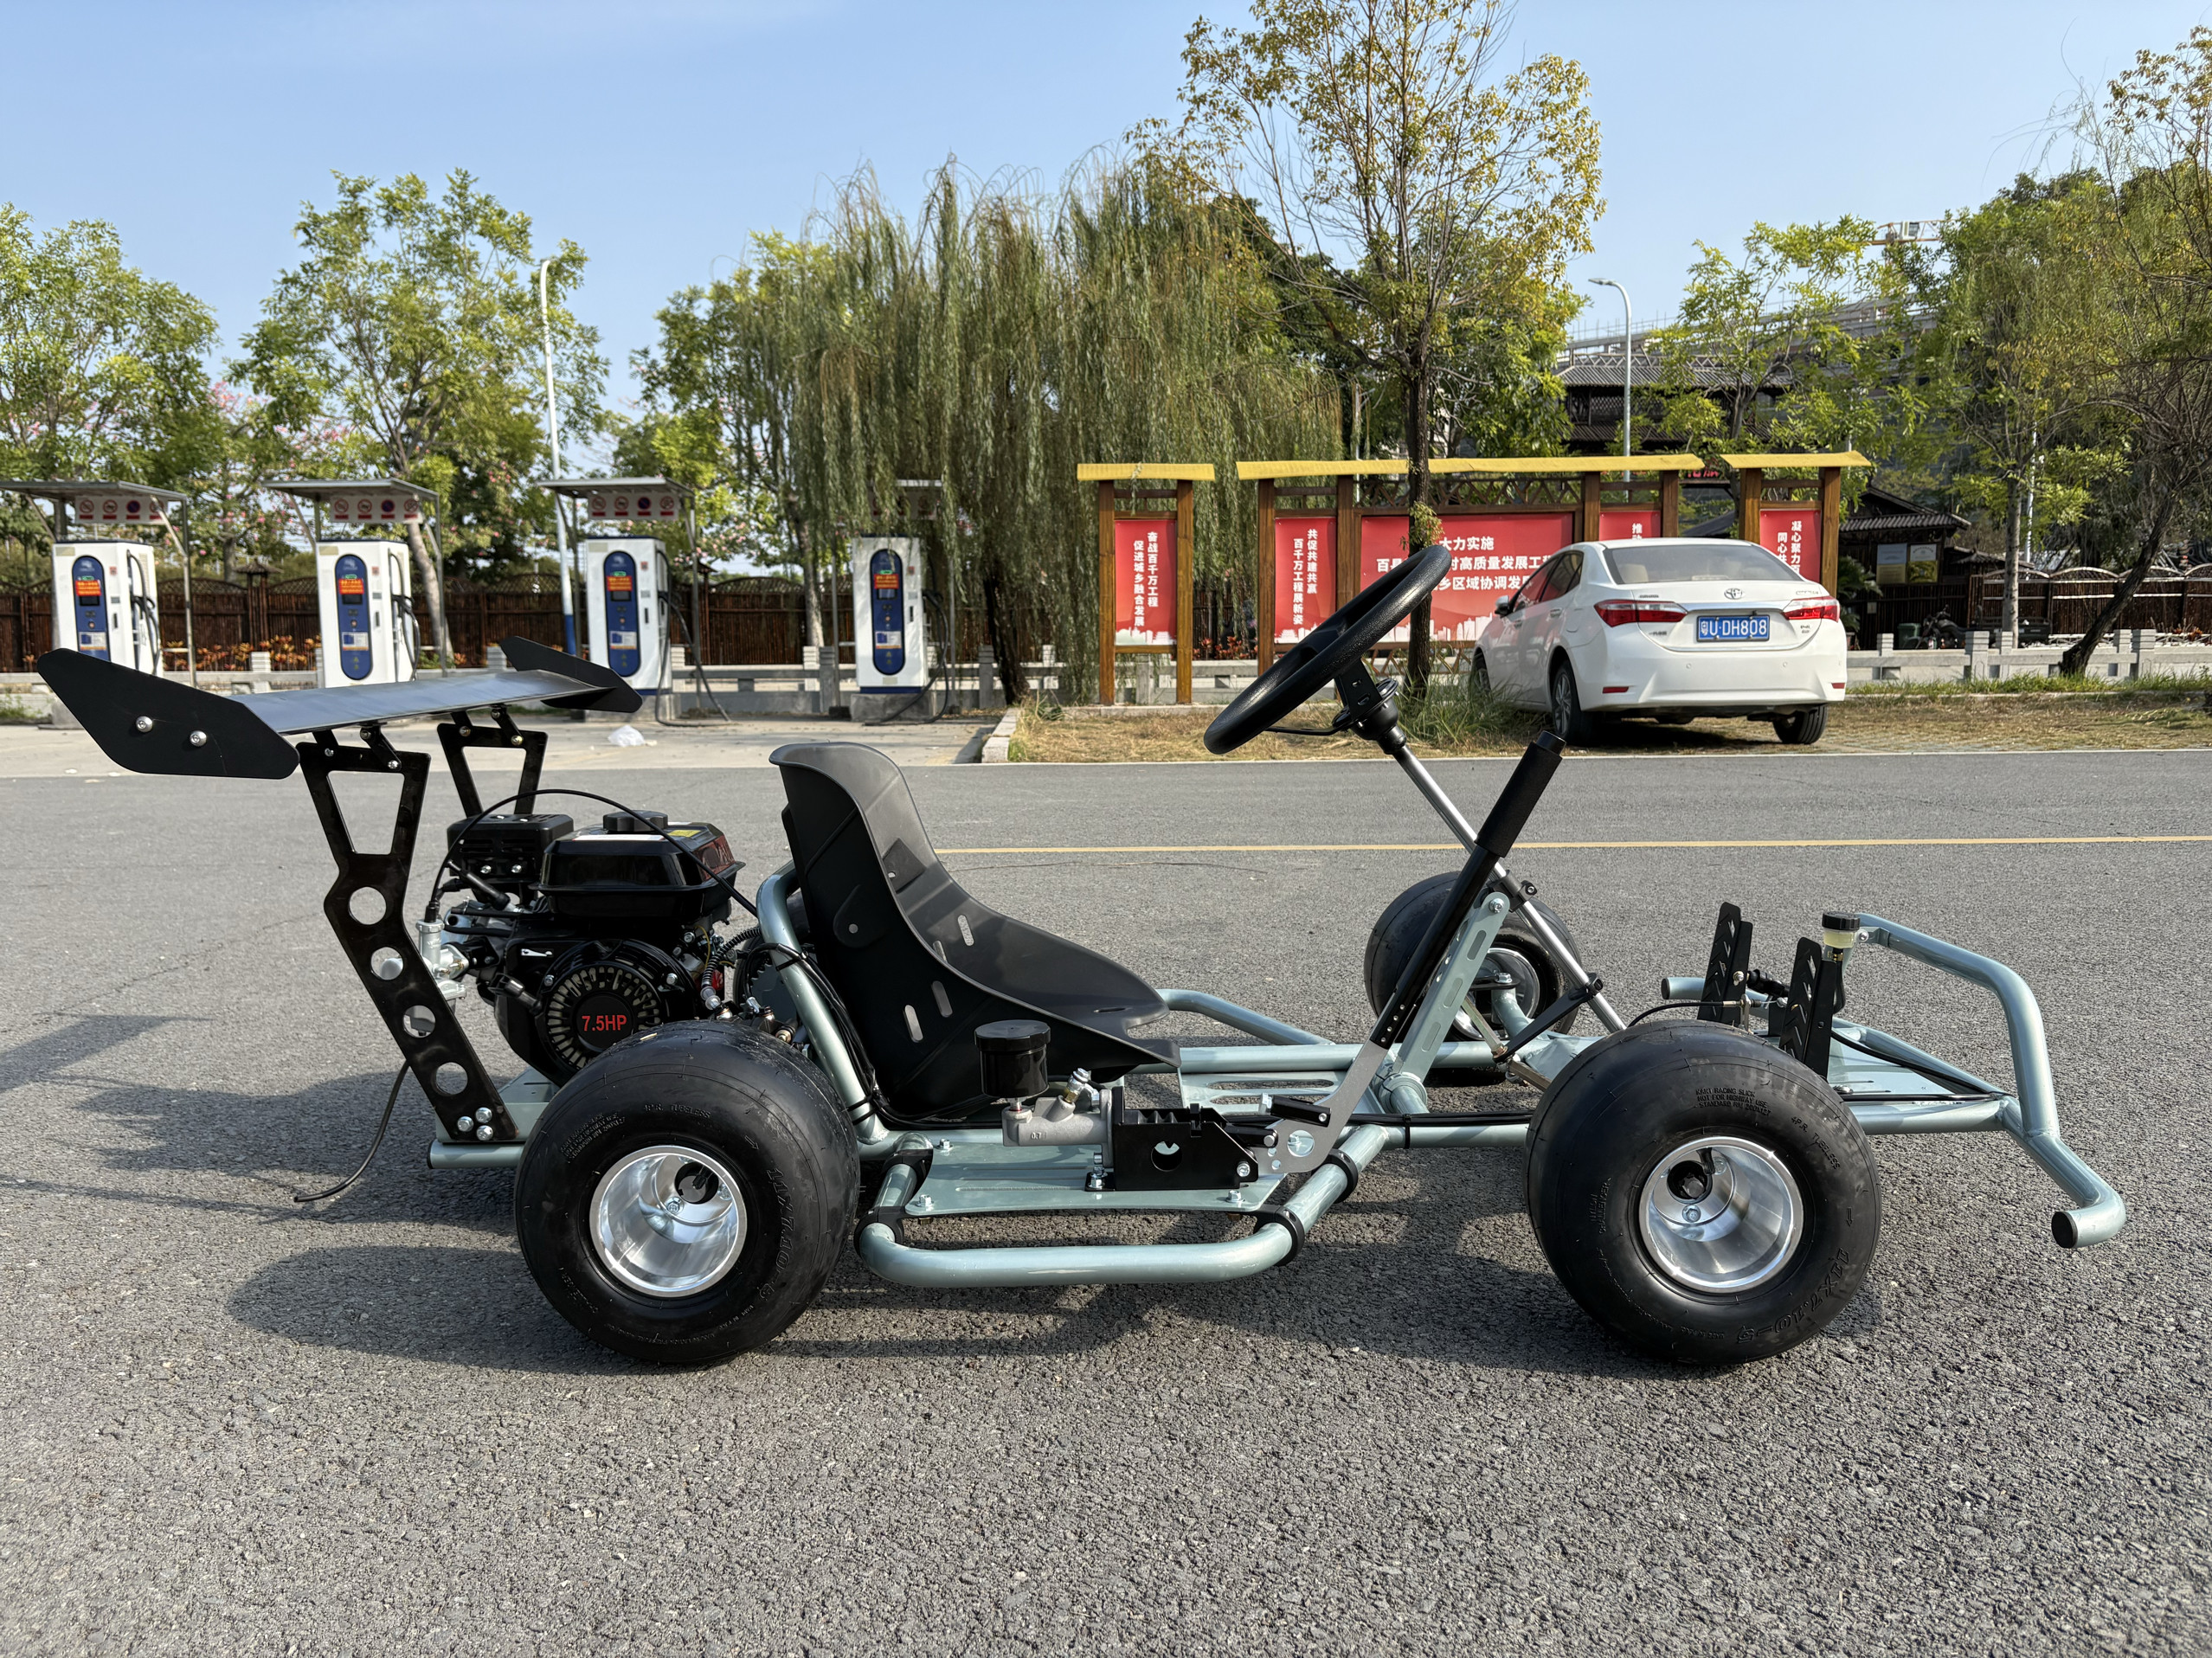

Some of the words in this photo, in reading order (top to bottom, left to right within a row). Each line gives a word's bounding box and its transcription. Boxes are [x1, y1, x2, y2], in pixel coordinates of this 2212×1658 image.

[1148, 531, 1159, 607] 奋战百千万工程
[1307, 529, 1318, 594] 共促共建共赢
[1438, 537, 1495, 551] 大力实施
[1134, 540, 1145, 627] 促进城乡融合发展
[1293, 538, 1304, 625] 百千万工程展新姿
[582, 1014, 627, 1031] 7.5HP
[670, 1103, 711, 1119] TUBELESS
